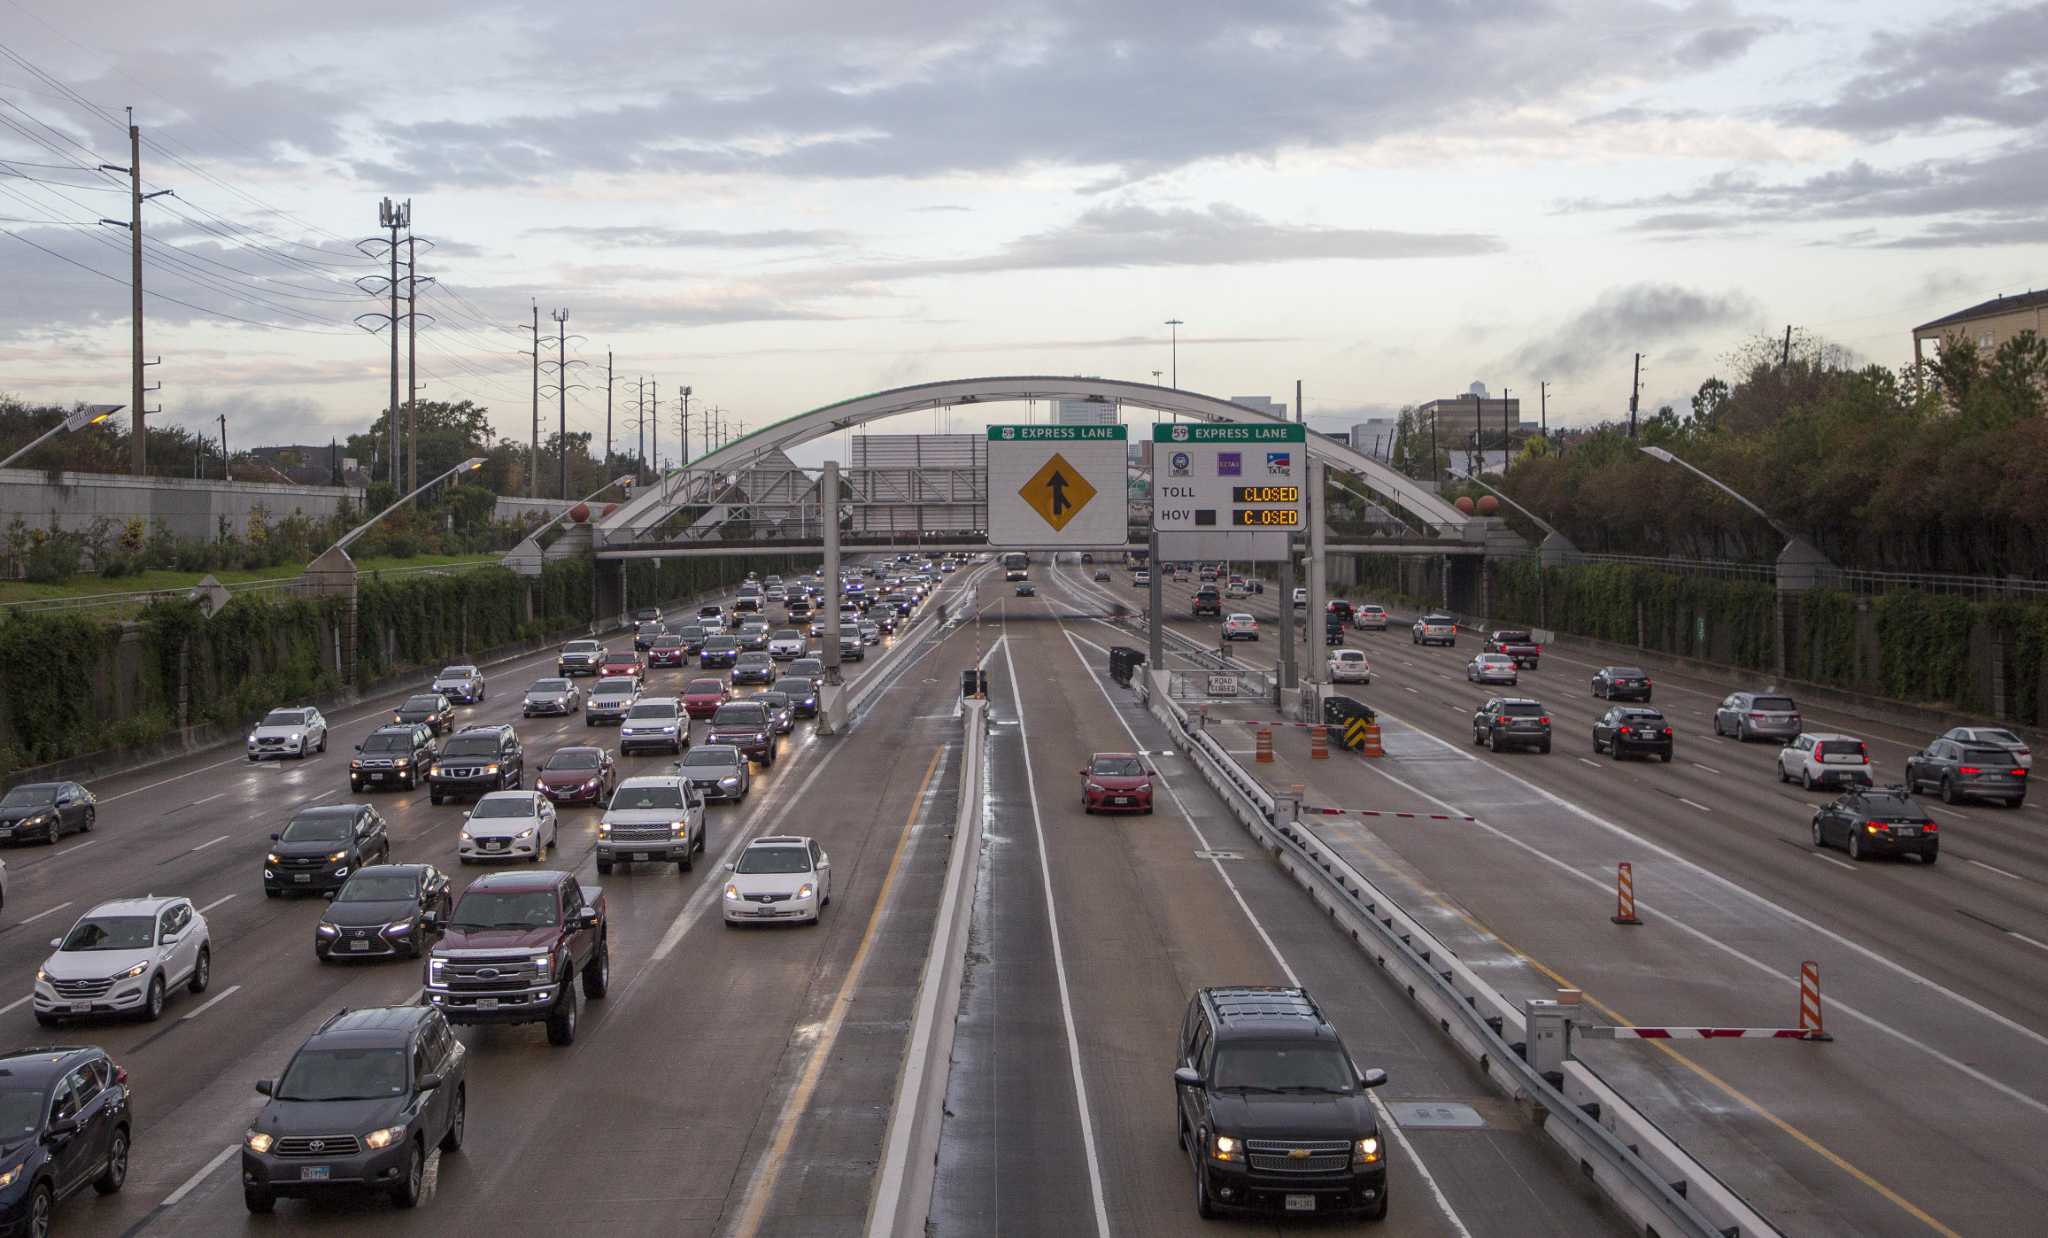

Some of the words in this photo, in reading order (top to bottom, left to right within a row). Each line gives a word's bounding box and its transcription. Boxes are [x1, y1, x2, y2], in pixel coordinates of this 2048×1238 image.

[1021, 428, 1075, 439] EXPRESS
[1081, 428, 1113, 439] LANE
[1173, 428, 1187, 438] 59
[1195, 428, 1249, 439] EXPRESS
[1255, 428, 1288, 439] LANE
[1161, 487, 1196, 498] TOLL
[1244, 487, 1298, 502] CLOSED
[1161, 510, 1190, 521] HOV
[1244, 510, 1298, 525] COSED
[1214, 677, 1233, 685] ROAD
